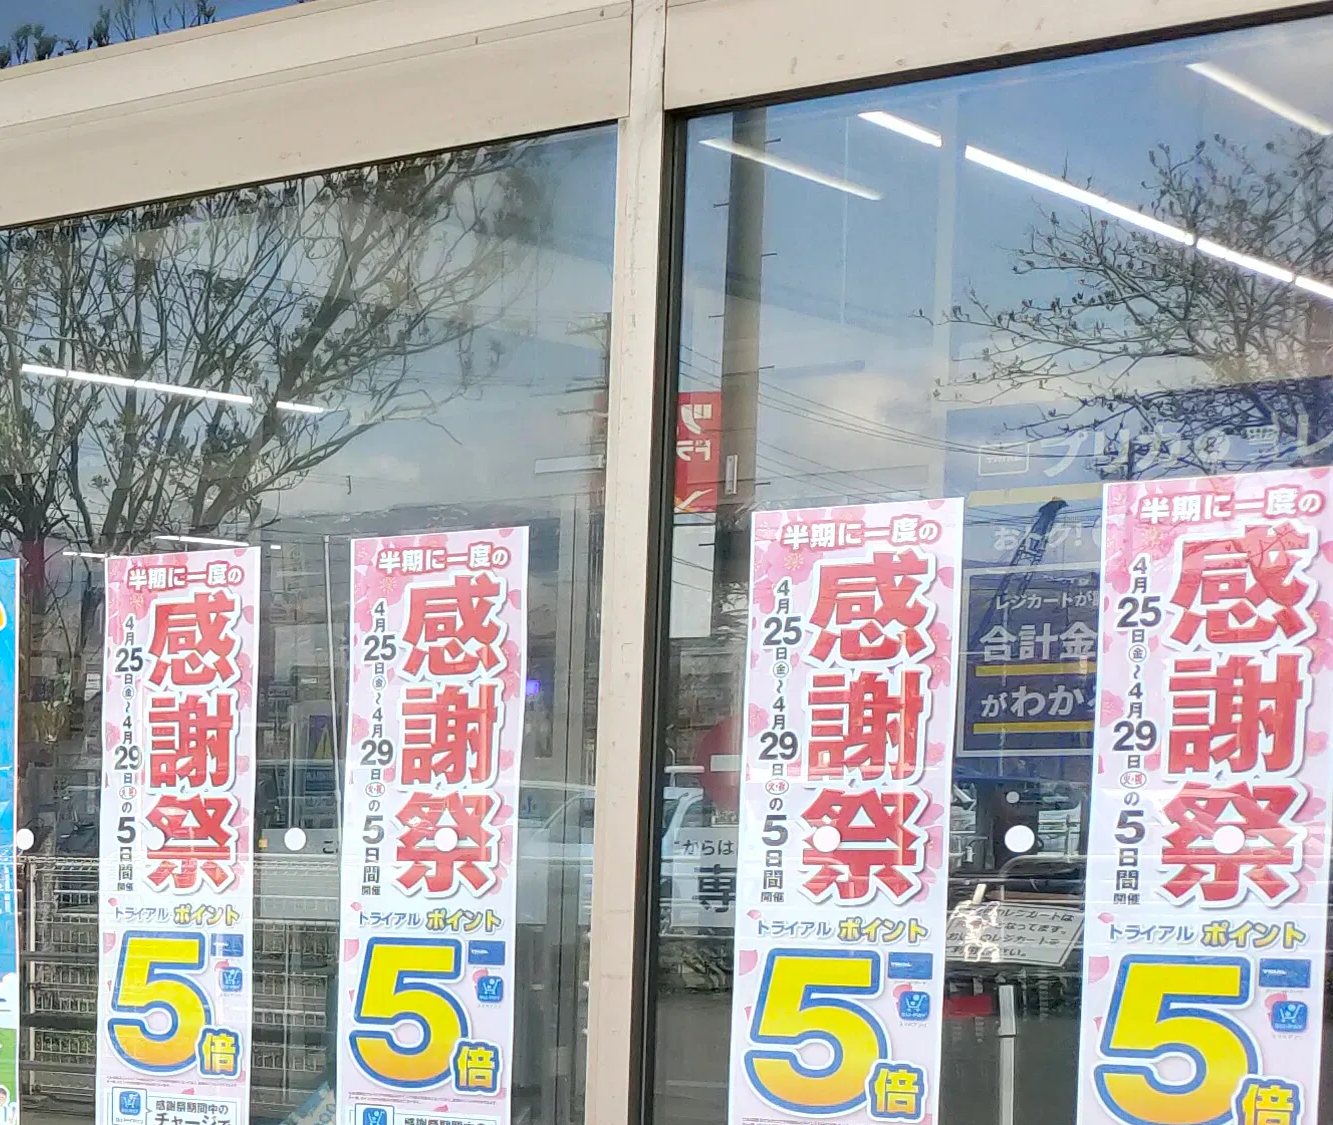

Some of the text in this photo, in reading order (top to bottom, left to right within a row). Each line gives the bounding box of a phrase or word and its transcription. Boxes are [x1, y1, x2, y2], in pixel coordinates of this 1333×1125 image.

[1140, 488, 1320, 524] 半期に一度の
[785, 518, 937, 549] 半期に一度の
[379, 543, 508, 574] 半期に一度の
[129, 563, 242, 590] 半期に一度の
[981, 685, 1096, 717] がわか
[1162, 522, 1310, 901] 感謝祭
[146, 590, 236, 888] 感謝祭
[395, 572, 501, 892] 感謝祭
[801, 549, 928, 899] 感謝祭
[115, 904, 239, 926] トライアル ポイント
[359, 908, 501, 932] トライアル ポイント
[758, 917, 928, 943] トライアル ポイント
[1109, 920, 1306, 949] トライアル ポイント
